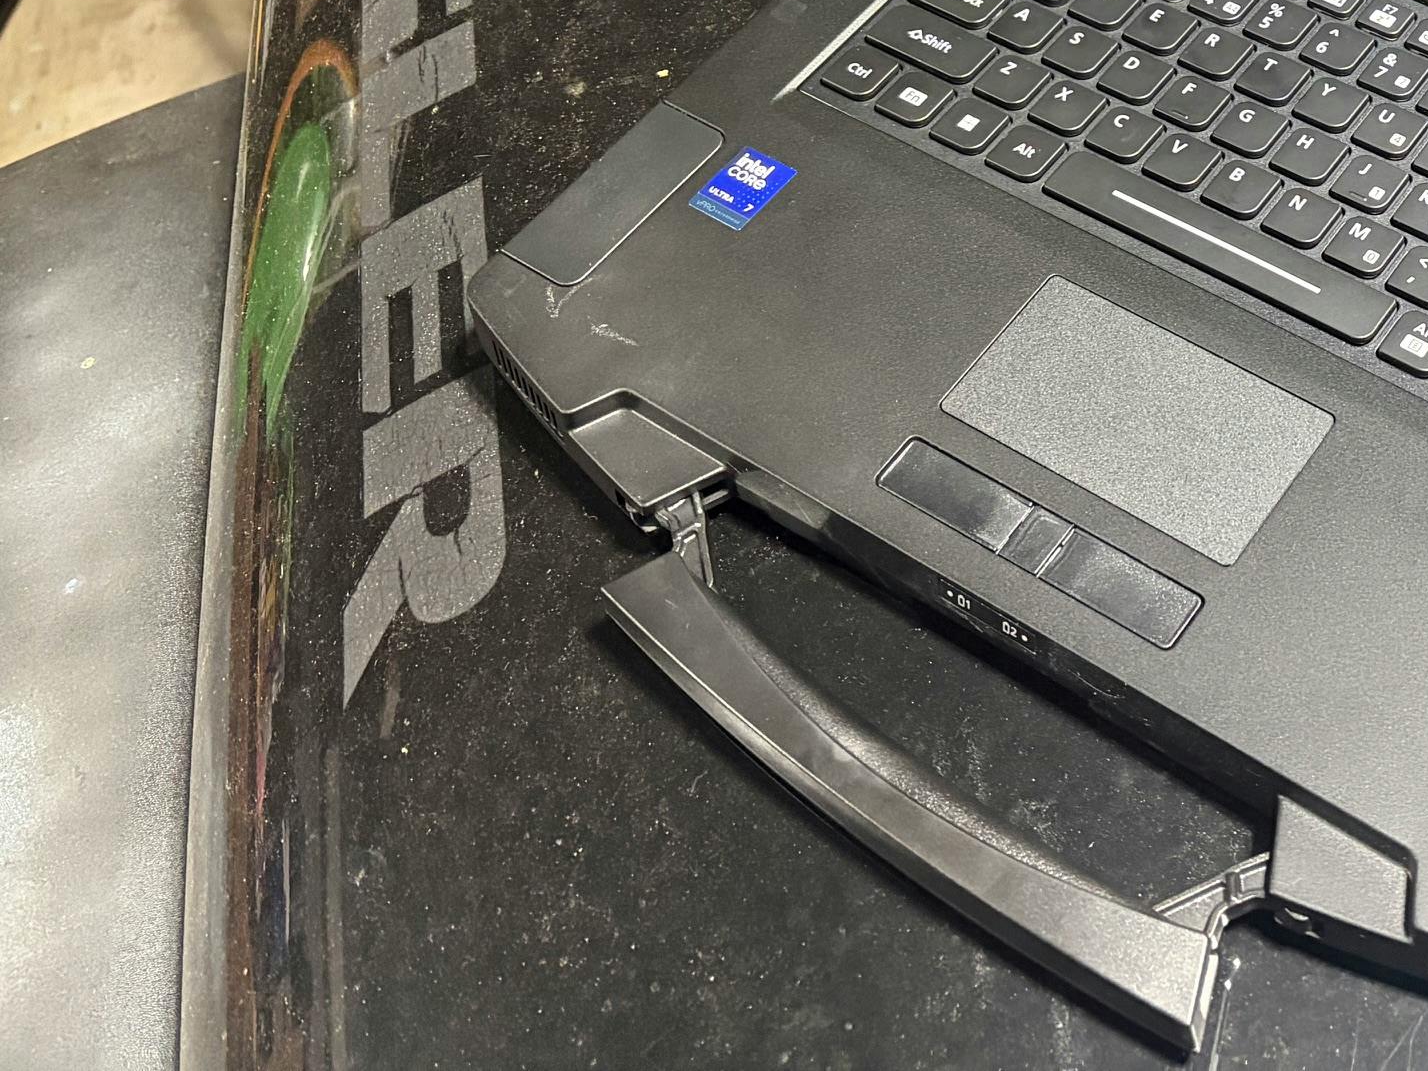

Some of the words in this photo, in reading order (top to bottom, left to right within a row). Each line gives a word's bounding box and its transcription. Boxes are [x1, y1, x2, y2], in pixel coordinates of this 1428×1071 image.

[1013, 8, 1030, 22] A
[1149, 9, 1165, 23] E
[1268, 2, 1285, 18] %
[1382, 3, 1399, 15] F7
[1258, 16, 1274, 29] 5
[921, 33, 953, 55] Shift
[1069, 31, 1085, 45] S
[1204, 33, 1221, 47] R
[1316, 41, 1330, 54] 6
[1122, 56, 1141, 70] D
[1264, 57, 1278, 72] T
[1382, 53, 1398, 68] &
[846, 62, 873, 79] Ctrl
[1000, 61, 1018, 75] Z
[1373, 65, 1389, 77] 7
[1054, 86, 1074, 102] X
[1181, 82, 1198, 95] F
[1321, 83, 1336, 96] Y
[905, 90, 921, 104] Fn
[1113, 114, 1130, 128] C
[1238, 109, 1256, 123] G
[1378, 109, 1396, 123] U
[1171, 139, 1189, 154] V
[1296, 134, 1315, 150] H
[1012, 142, 1036, 159] Alt
[735, 152, 776, 179] intel
[1358, 163, 1372, 175] J
[1228, 167, 1246, 182] B
[708, 185, 735, 204] ULTRA
[743, 203, 755, 212] 7
[1288, 195, 1308, 212] N
[1348, 222, 1372, 241] M
